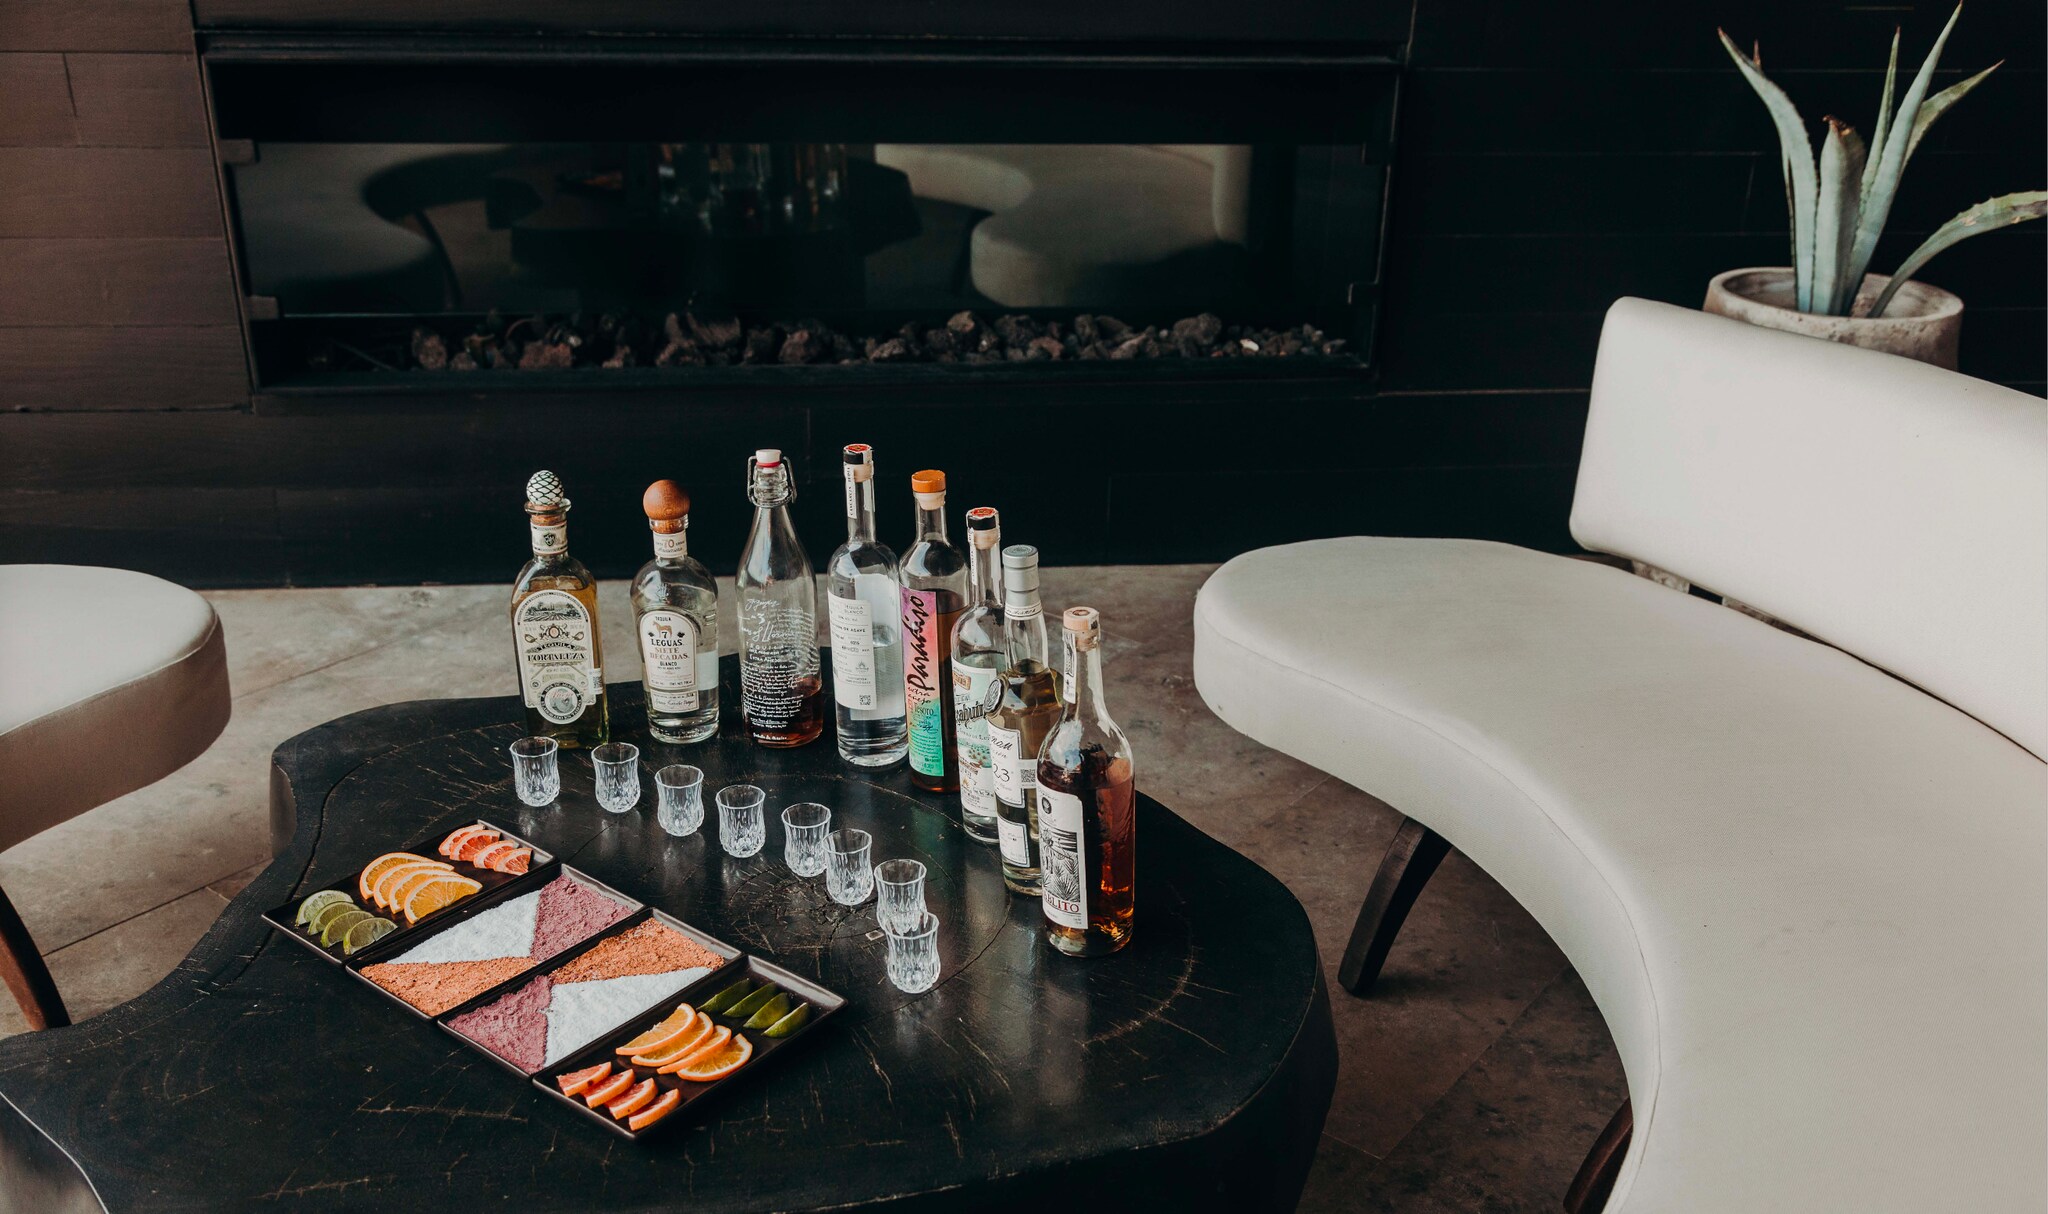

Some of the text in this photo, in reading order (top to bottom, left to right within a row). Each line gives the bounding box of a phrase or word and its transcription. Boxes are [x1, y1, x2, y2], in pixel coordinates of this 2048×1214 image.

[661, 631, 668, 639] 7
[536, 642, 575, 651] TEQUILA
[651, 639, 683, 647] LEGUAS
[902, 595, 936, 692] Paradiso
[527, 653, 585, 661] FORTALEZA
